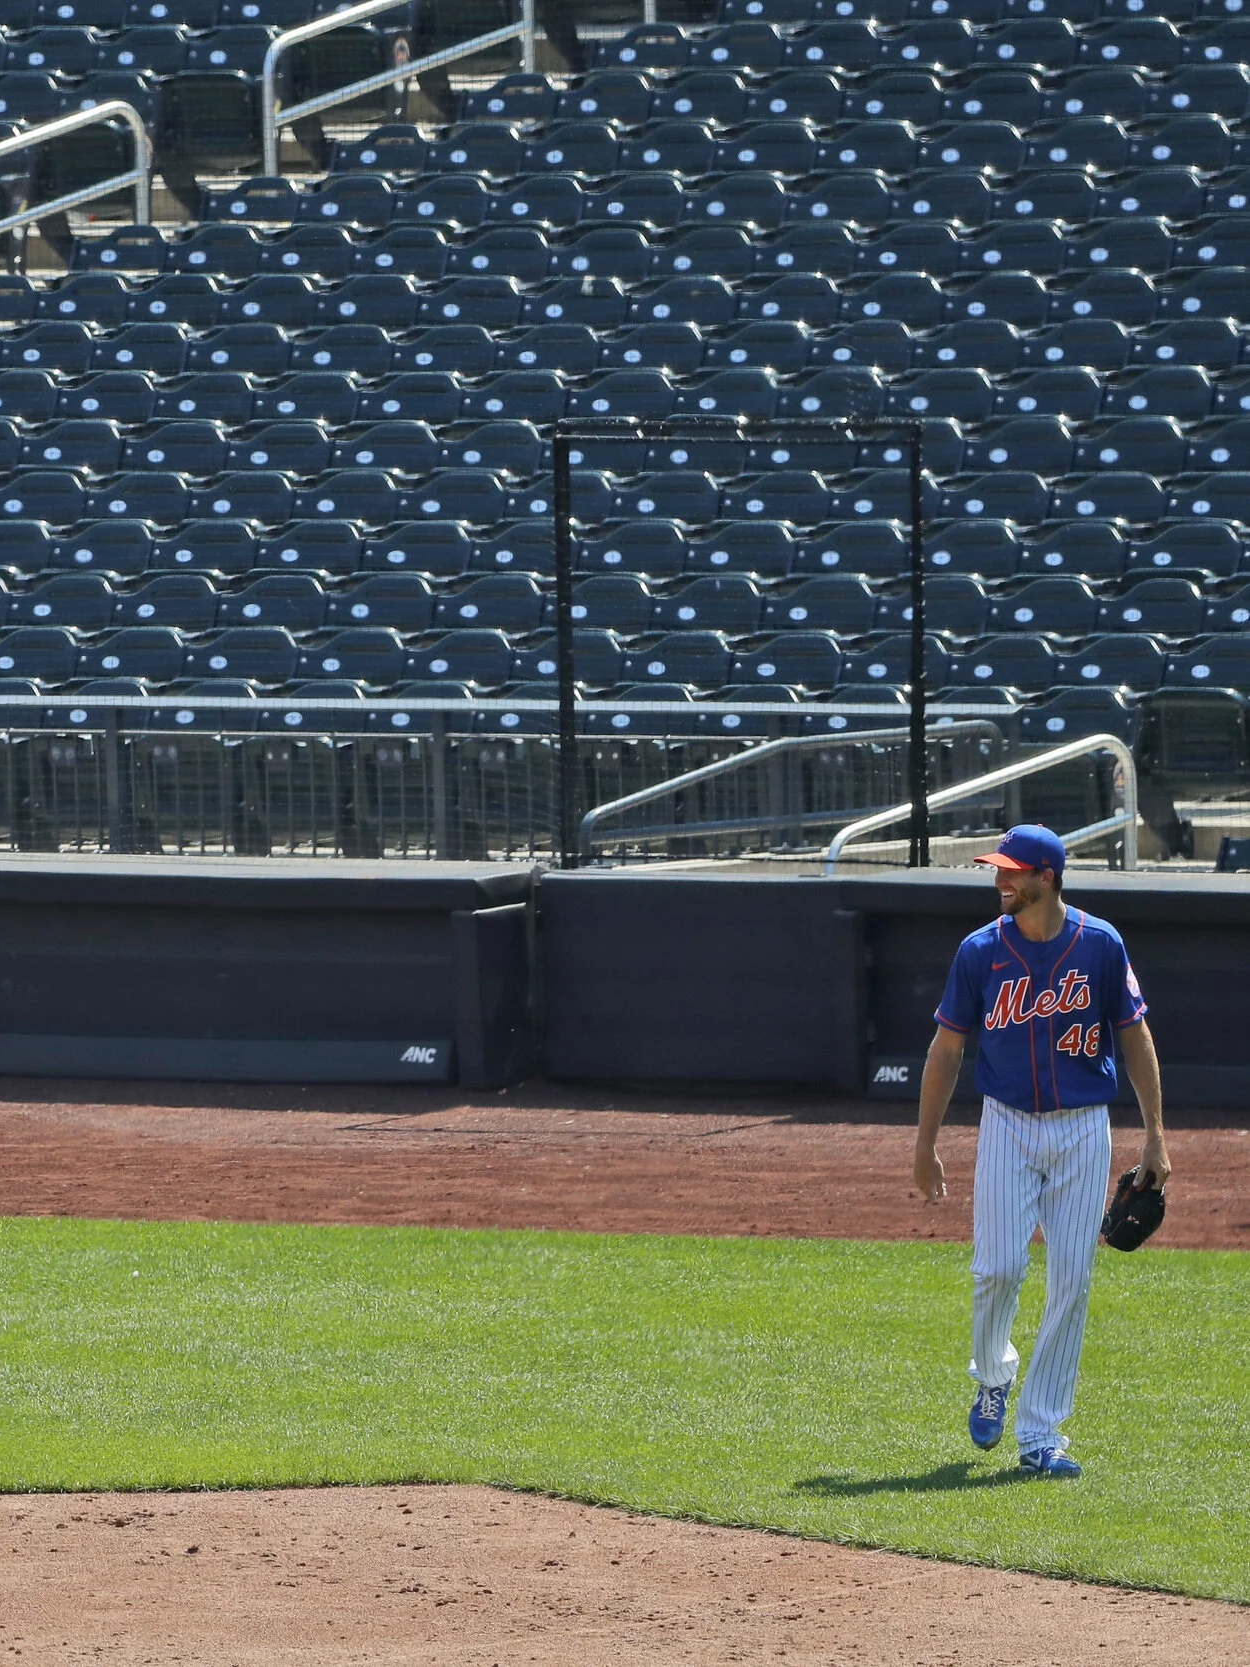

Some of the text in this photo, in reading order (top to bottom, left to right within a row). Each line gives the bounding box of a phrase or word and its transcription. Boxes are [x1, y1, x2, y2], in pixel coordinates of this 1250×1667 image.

[985, 969, 1090, 1030] Mets
[1057, 1022, 1100, 1057] 48
[400, 1046, 437, 1064] ANC
[873, 1066, 909, 1082] ANC
